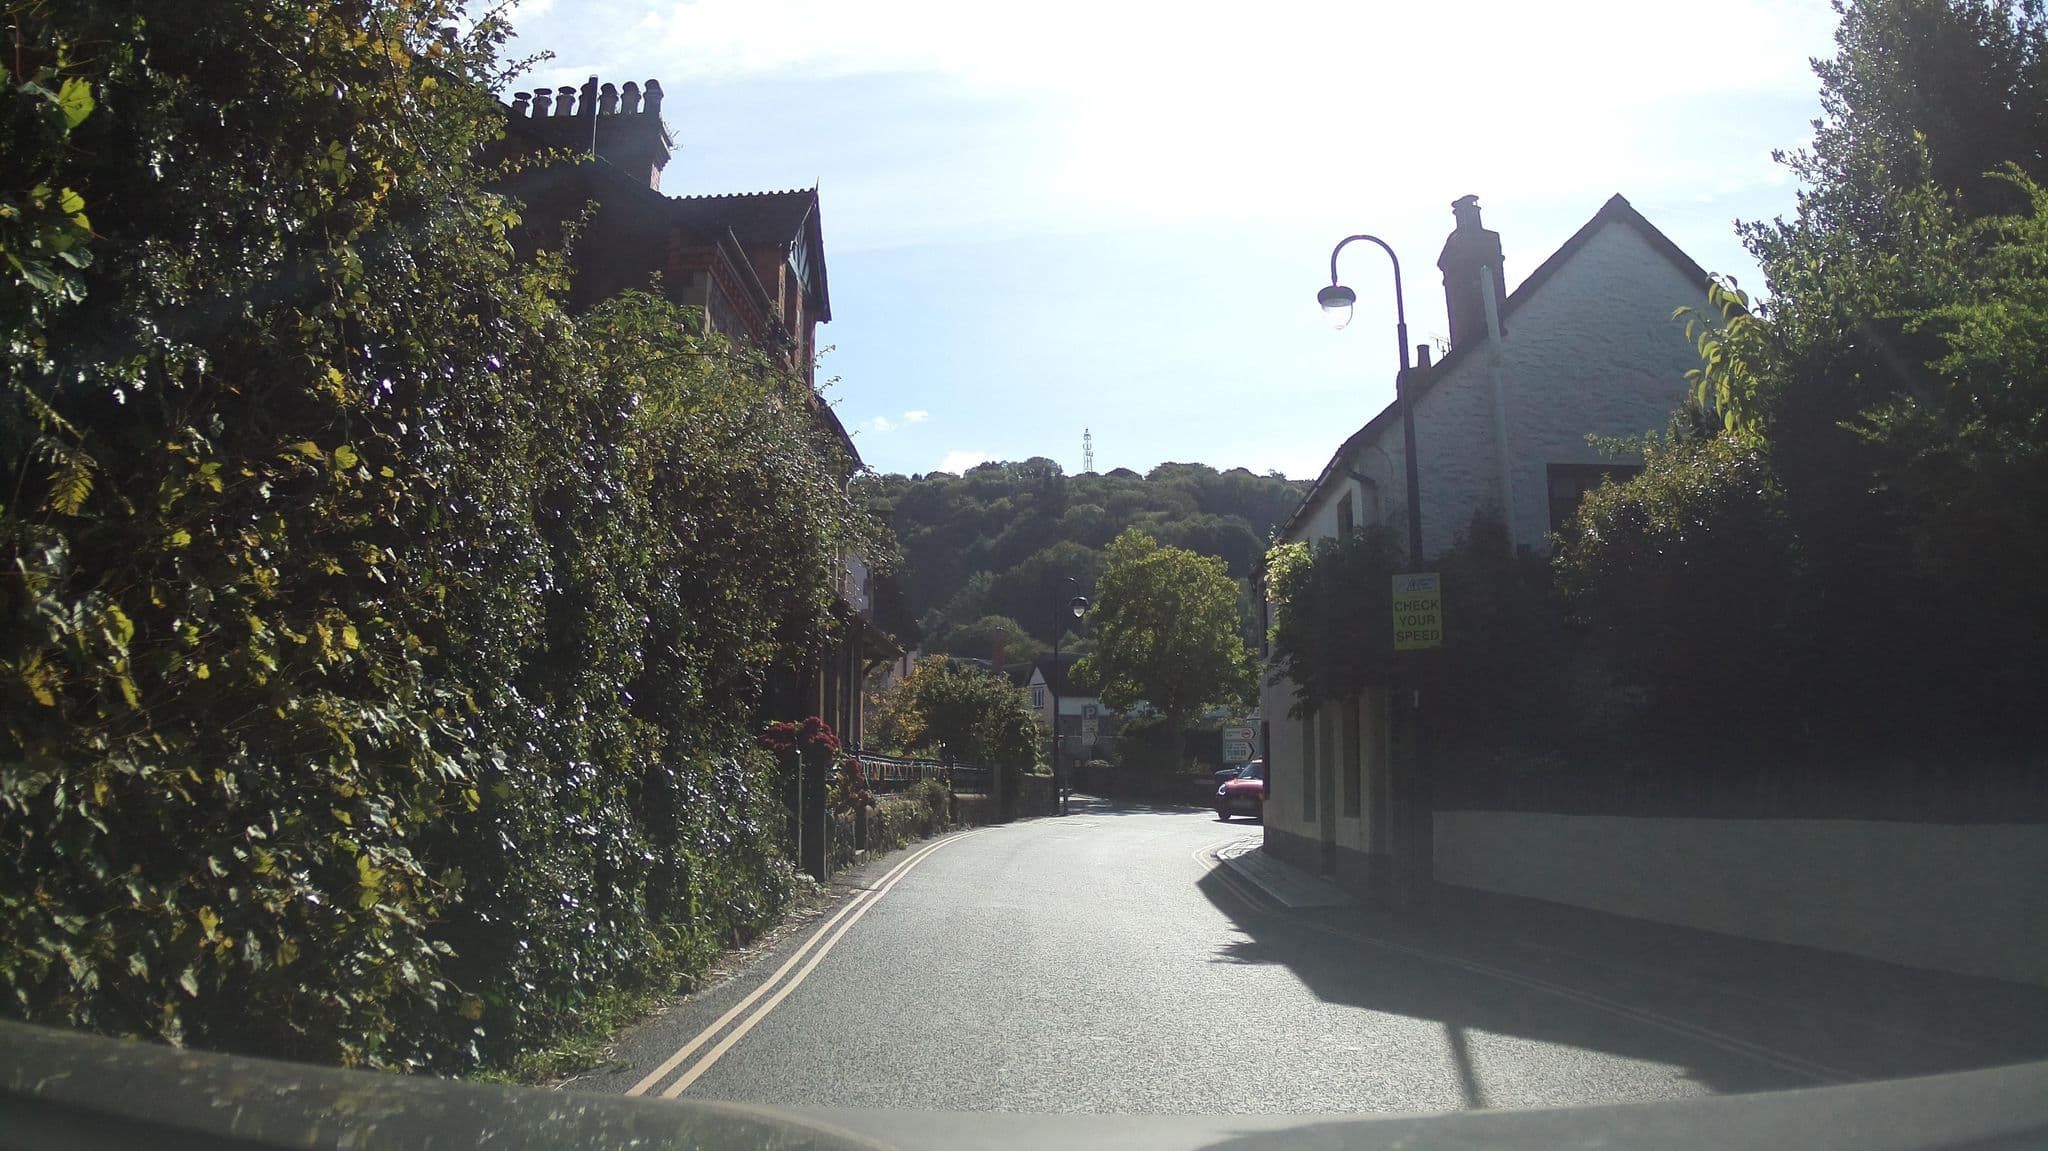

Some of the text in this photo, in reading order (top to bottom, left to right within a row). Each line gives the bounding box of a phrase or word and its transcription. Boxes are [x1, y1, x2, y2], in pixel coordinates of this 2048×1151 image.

[1394, 599, 1439, 612] CHECK
[1399, 615, 1436, 626] YOUR
[1395, 630, 1440, 642] SPEED
[1086, 707, 1096, 719] P
